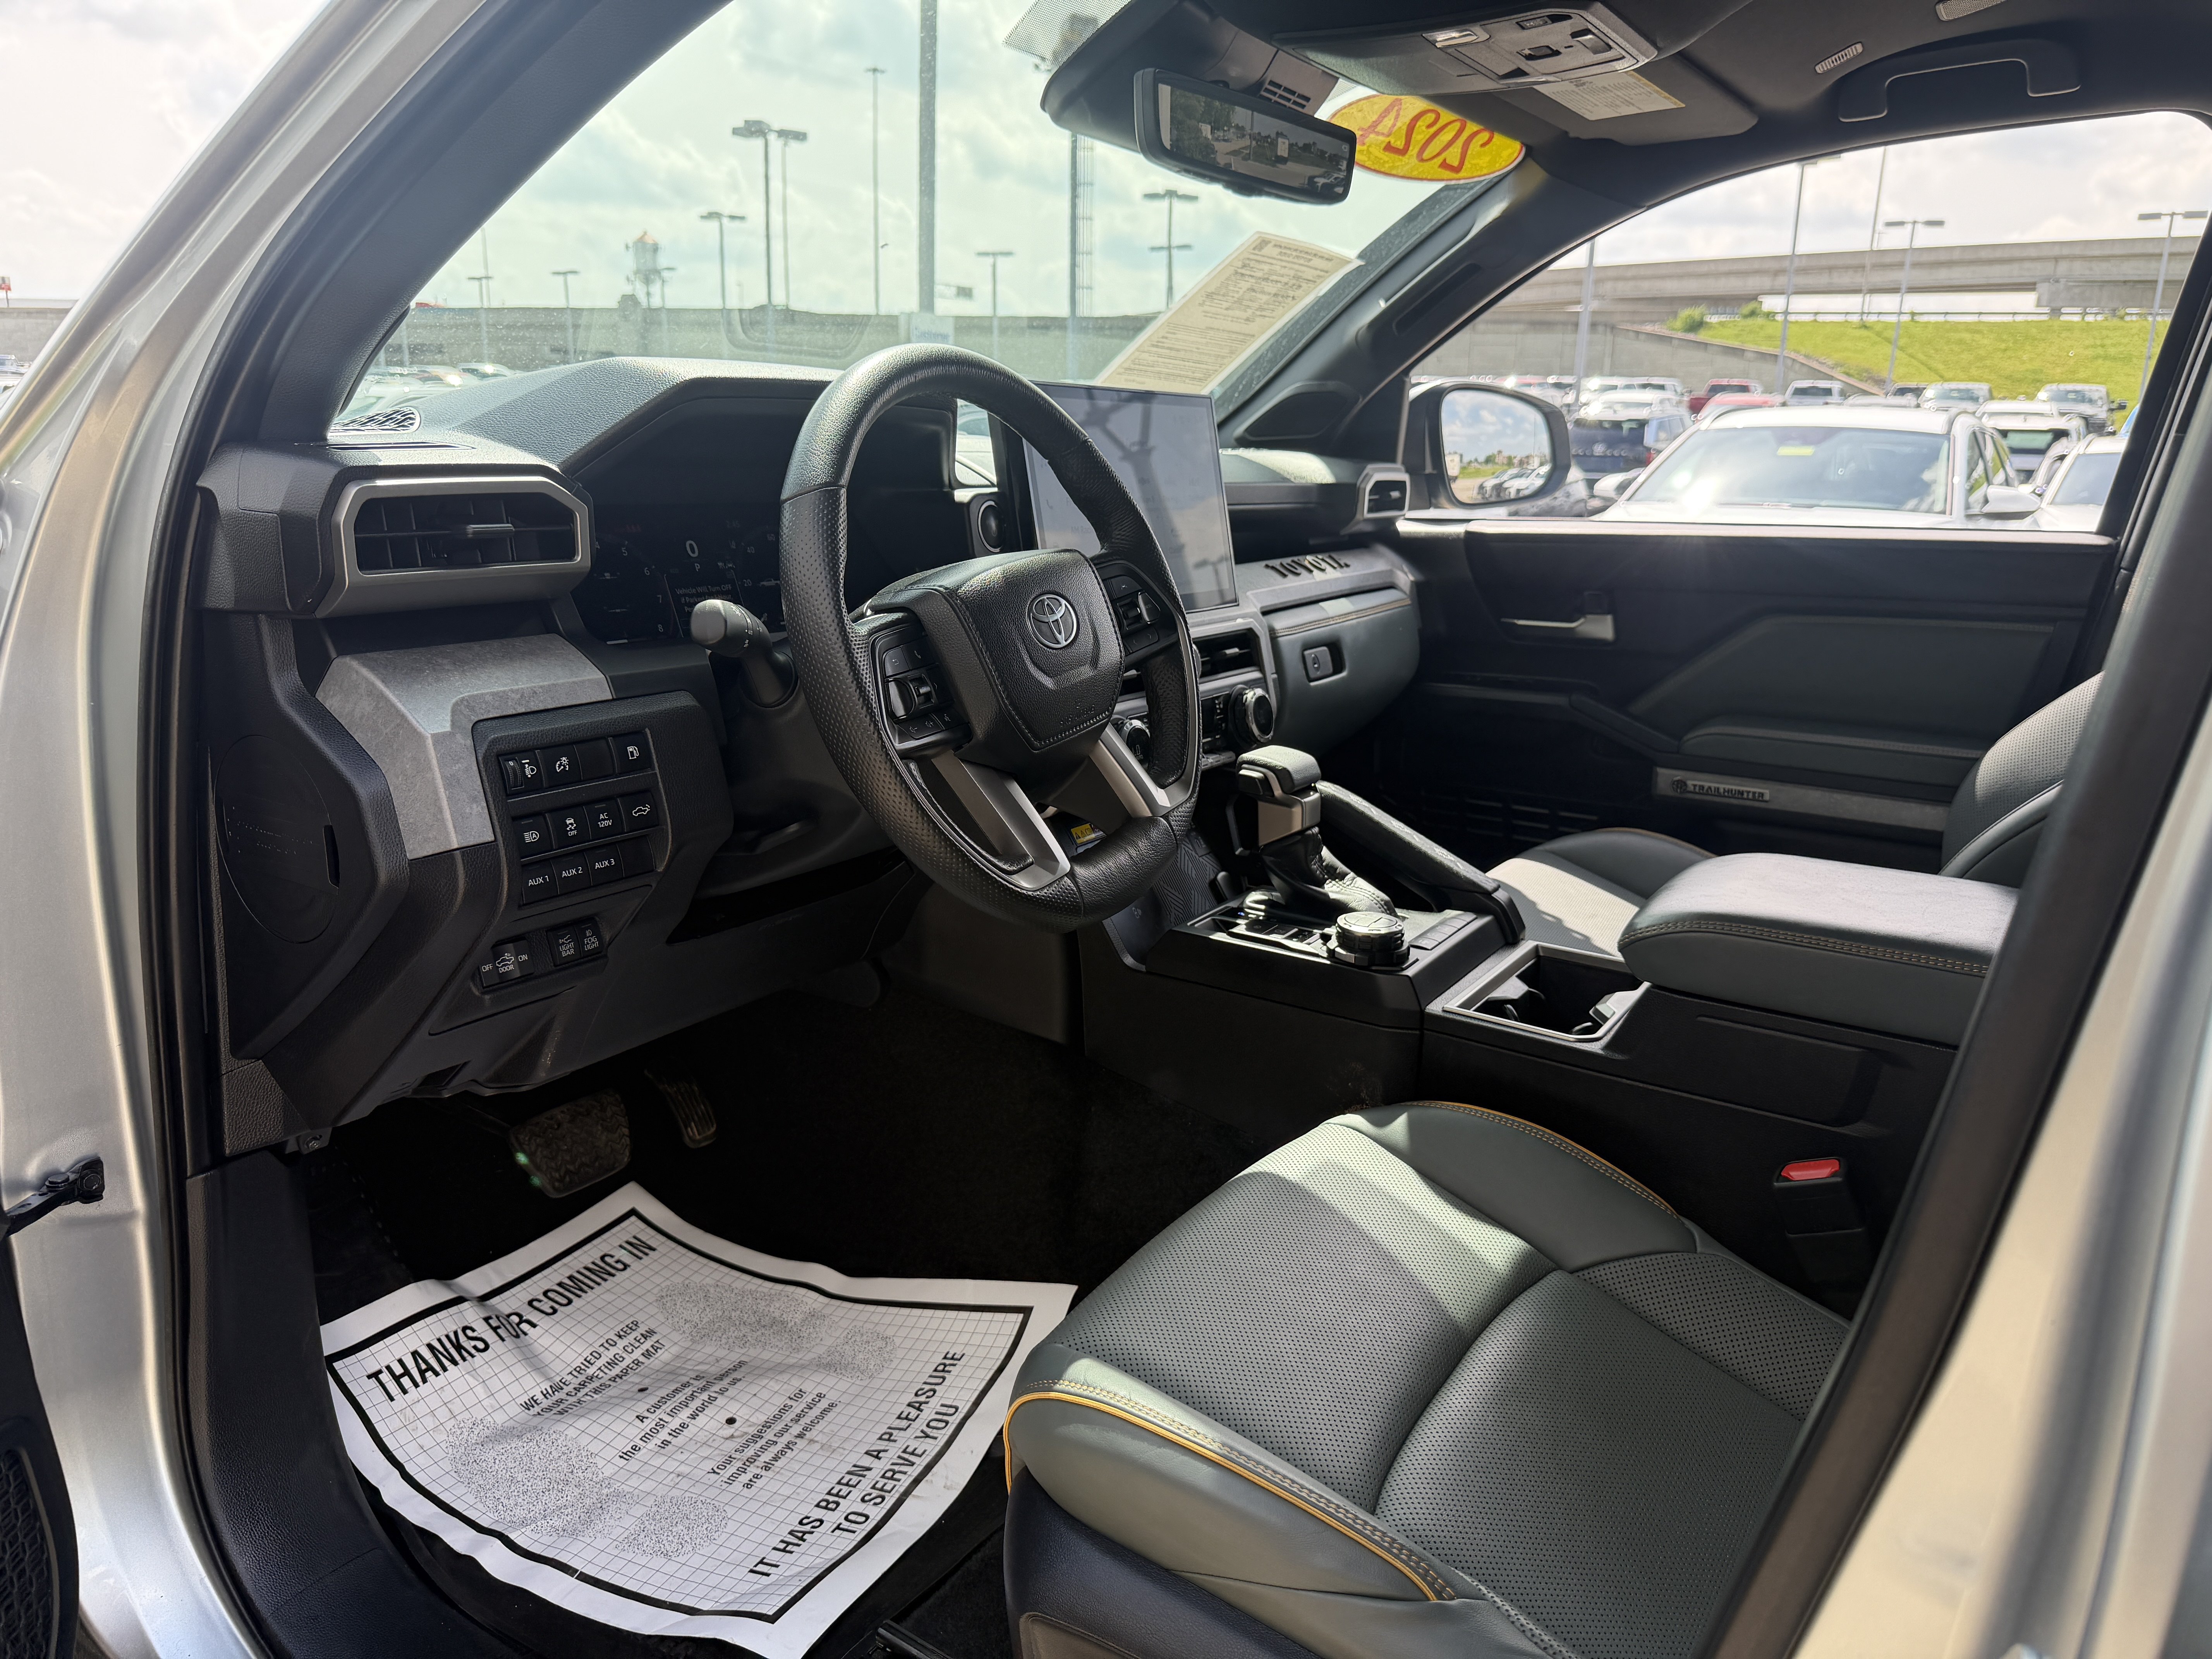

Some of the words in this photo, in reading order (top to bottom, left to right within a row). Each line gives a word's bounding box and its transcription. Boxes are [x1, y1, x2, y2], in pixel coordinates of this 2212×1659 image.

[622, 547, 627, 556] 5
[685, 540, 699, 558] 0
[644, 567, 649, 576] 6
[694, 563, 700, 572] P
[657, 595, 662, 603] 7
[658, 624, 663, 632] 8
[1691, 783, 1764, 800] TRAILHUNTER
[598, 819, 612, 828] 120V
[595, 860, 608, 869] AUX
[562, 868, 576, 878] AUX
[528, 877, 543, 886] AUX
[584, 936, 597, 945] FOG
[584, 941, 599, 950] LIGHT
[560, 942, 574, 951] LIGHT
[562, 949, 575, 957] BAR
[482, 963, 493, 972] OFF
[499, 964, 515, 973] DOOR
[366, 1324, 490, 1403] THANKS
[483, 1311, 538, 1343] FOR
[527, 1252, 631, 1317] COMING
[618, 1235, 658, 1261] IN
[520, 1395, 543, 1411] WE
[540, 1377, 571, 1400] HAVE
[567, 1350, 602, 1378] TRIED
[599, 1338, 617, 1351] TO
[615, 1320, 641, 1340] KEEP
[532, 1396, 569, 1417] YOUR
[567, 1353, 625, 1397] CARPETING
[623, 1328, 658, 1354] CLEAN
[553, 1396, 586, 1417] WITH
[583, 1382, 611, 1399] THIS
[608, 1358, 645, 1383] PAPER
[641, 1339, 666, 1360] MAT
[635, 1414, 649, 1423] A
[646, 1381, 694, 1414] customer
[691, 1374, 705, 1386] is
[619, 1444, 641, 1461] the
[639, 1417, 669, 1443] most
[664, 1381, 715, 1418] important
[714, 1360, 748, 1382] person
[655, 1439, 672, 1449] in
[668, 1422, 689, 1438] the
[687, 1394, 718, 1420] world
[715, 1386, 729, 1395] to
[727, 1376, 746, 1386] us.
[708, 1454, 737, 1475] Your
[734, 1403, 793, 1454] suggestions
[788, 1388, 807, 1403] for
[721, 1439, 778, 1485] improving
[774, 1423, 793, 1437] our
[790, 1392, 826, 1424] service
[743, 1473, 763, 1489] are
[761, 1439, 797, 1472] always
[794, 1400, 841, 1439] welcome.
[748, 1556, 780, 1577] IT
[771, 1515, 825, 1554] HAS
[814, 1463, 873, 1512] BEEN
[864, 1448, 889, 1460] A
[877, 1351, 966, 1443] PLEASURE
[831, 1510, 870, 1534] TO
[860, 1444, 928, 1506] SERVE
[914, 1403, 960, 1441] YOU
